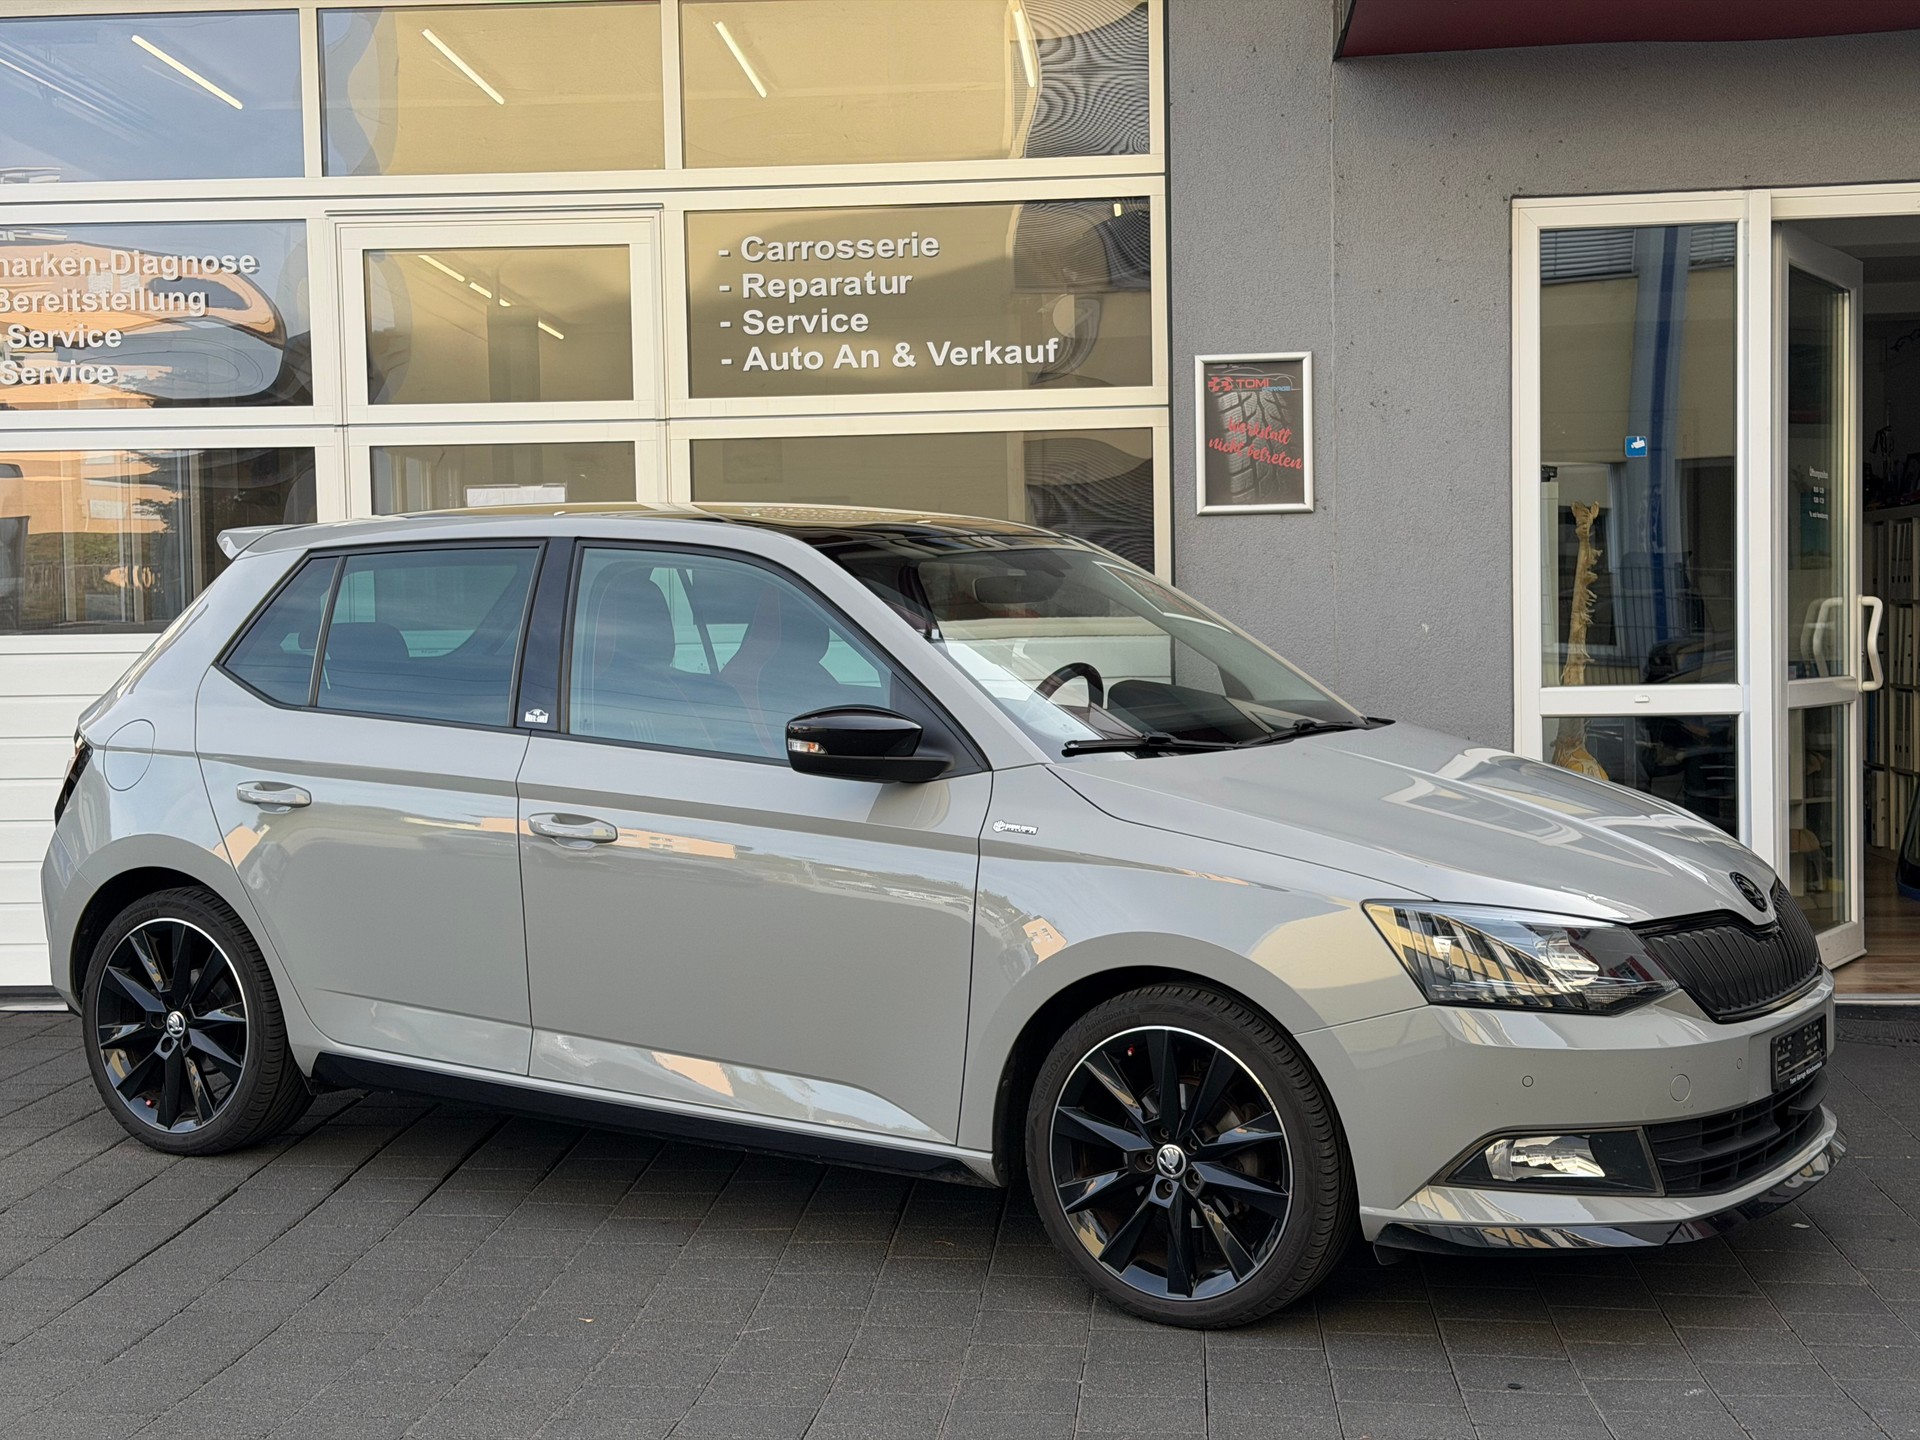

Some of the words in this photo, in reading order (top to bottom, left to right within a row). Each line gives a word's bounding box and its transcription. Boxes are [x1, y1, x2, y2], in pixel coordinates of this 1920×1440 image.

[741, 232, 940, 262] Carrosserie
[742, 271, 913, 303] Reparatur
[742, 308, 869, 335] Service
[7, 324, 121, 348] Service
[743, 346, 824, 372] Auto
[833, 344, 880, 369] An
[892, 342, 917, 368] &
[926, 337, 1059, 367] Verkauf
[0, 360, 114, 385] Service
[1247, 445, 1303, 469] betreten
